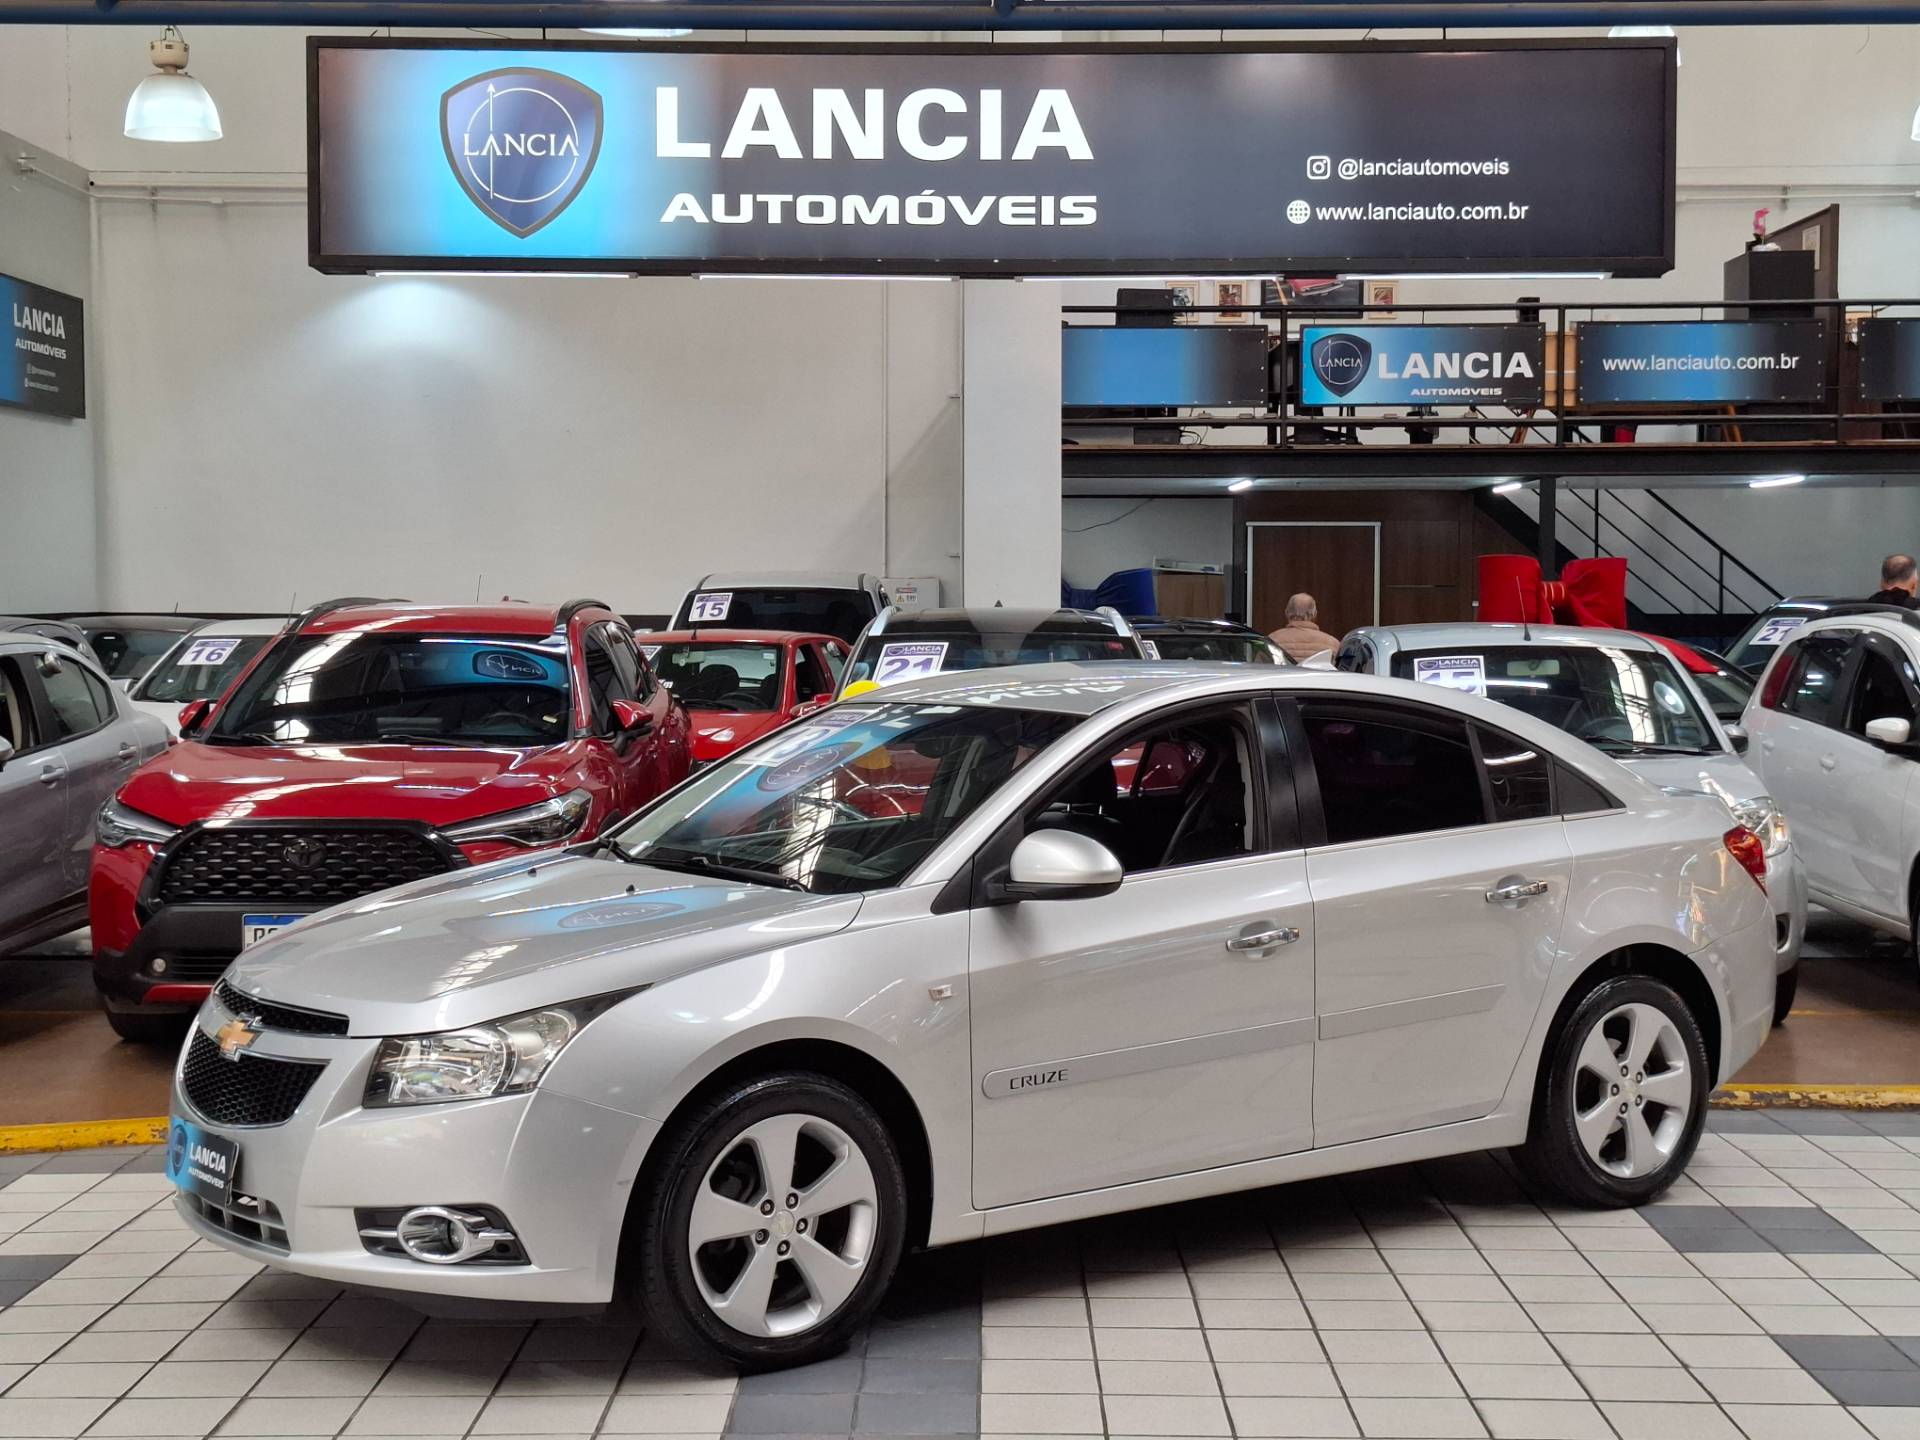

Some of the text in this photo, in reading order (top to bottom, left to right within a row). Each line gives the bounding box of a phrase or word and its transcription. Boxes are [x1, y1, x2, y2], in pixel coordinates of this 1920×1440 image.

[656, 86, 1095, 162] LANCIA
[463, 132, 580, 157] LANCIA
[1337, 157, 1511, 182] @lanciautomoveis
[660, 188, 1098, 227] AUTOMÓVEIS
[1314, 201, 1530, 222] www.lanciauto.com.br
[13, 302, 66, 340] LANCIA
[15, 337, 67, 360] AUTOMÓVEIS
[1318, 356, 1363, 369] LANCIA
[1377, 351, 1535, 380] LANCIA
[1602, 353, 1800, 371] www.lanciauto.com.br
[1410, 386, 1503, 397] AUTOMÓVEIS
[696, 602, 725, 618] 15
[1757, 627, 1793, 642] 21
[191, 647, 227, 662] 16
[905, 645, 941, 653] LANCIA
[880, 657, 934, 681] 21
[1439, 658, 1479, 666] LANCIA
[1009, 1068, 1070, 1090] CRUZE
[190, 1141, 226, 1174] LANCIA
